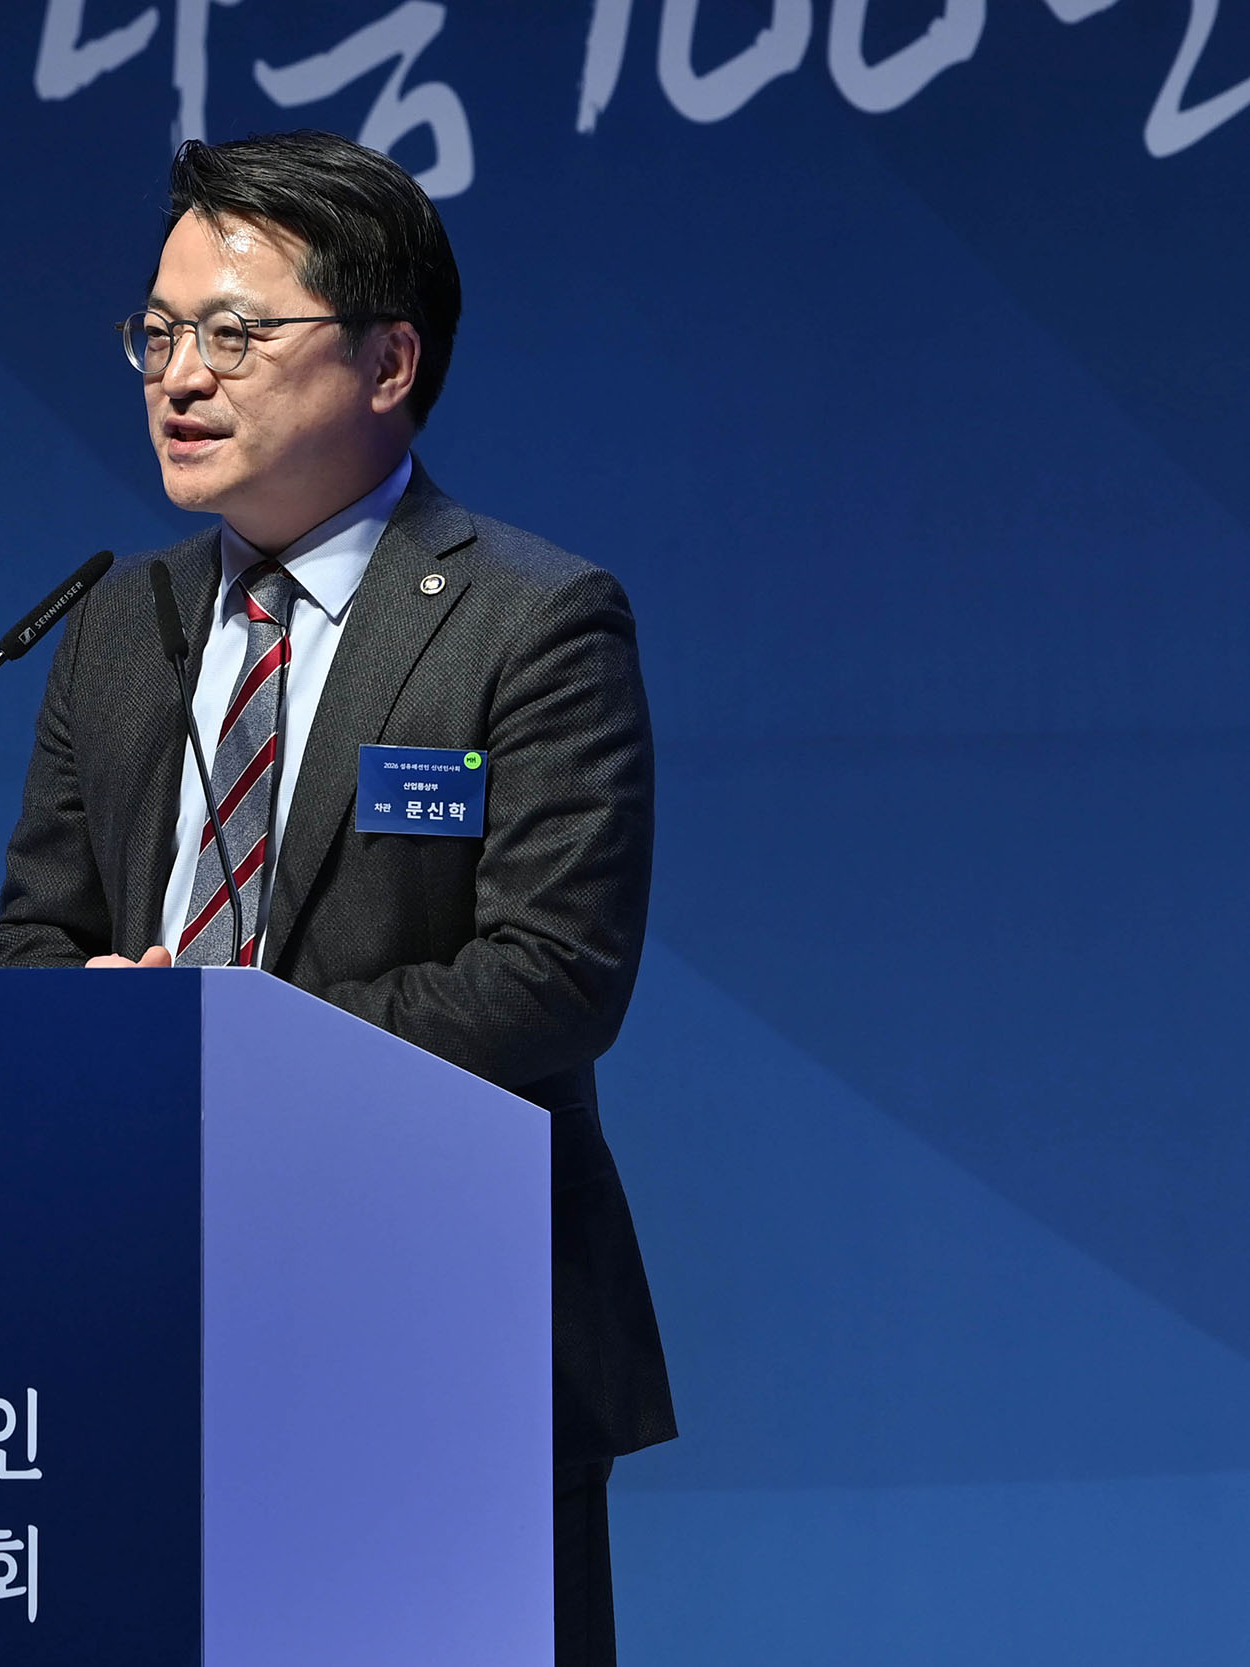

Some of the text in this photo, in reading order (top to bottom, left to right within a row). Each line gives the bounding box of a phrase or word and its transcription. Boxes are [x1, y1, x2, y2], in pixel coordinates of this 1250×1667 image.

[34, 581, 84, 630] SENNHEISER
[383, 762, 399, 770] 2026
[431, 764, 461, 773] 신년인사회
[403, 782, 439, 792] 산업통상부
[374, 800, 467, 822] 차관 문신학
